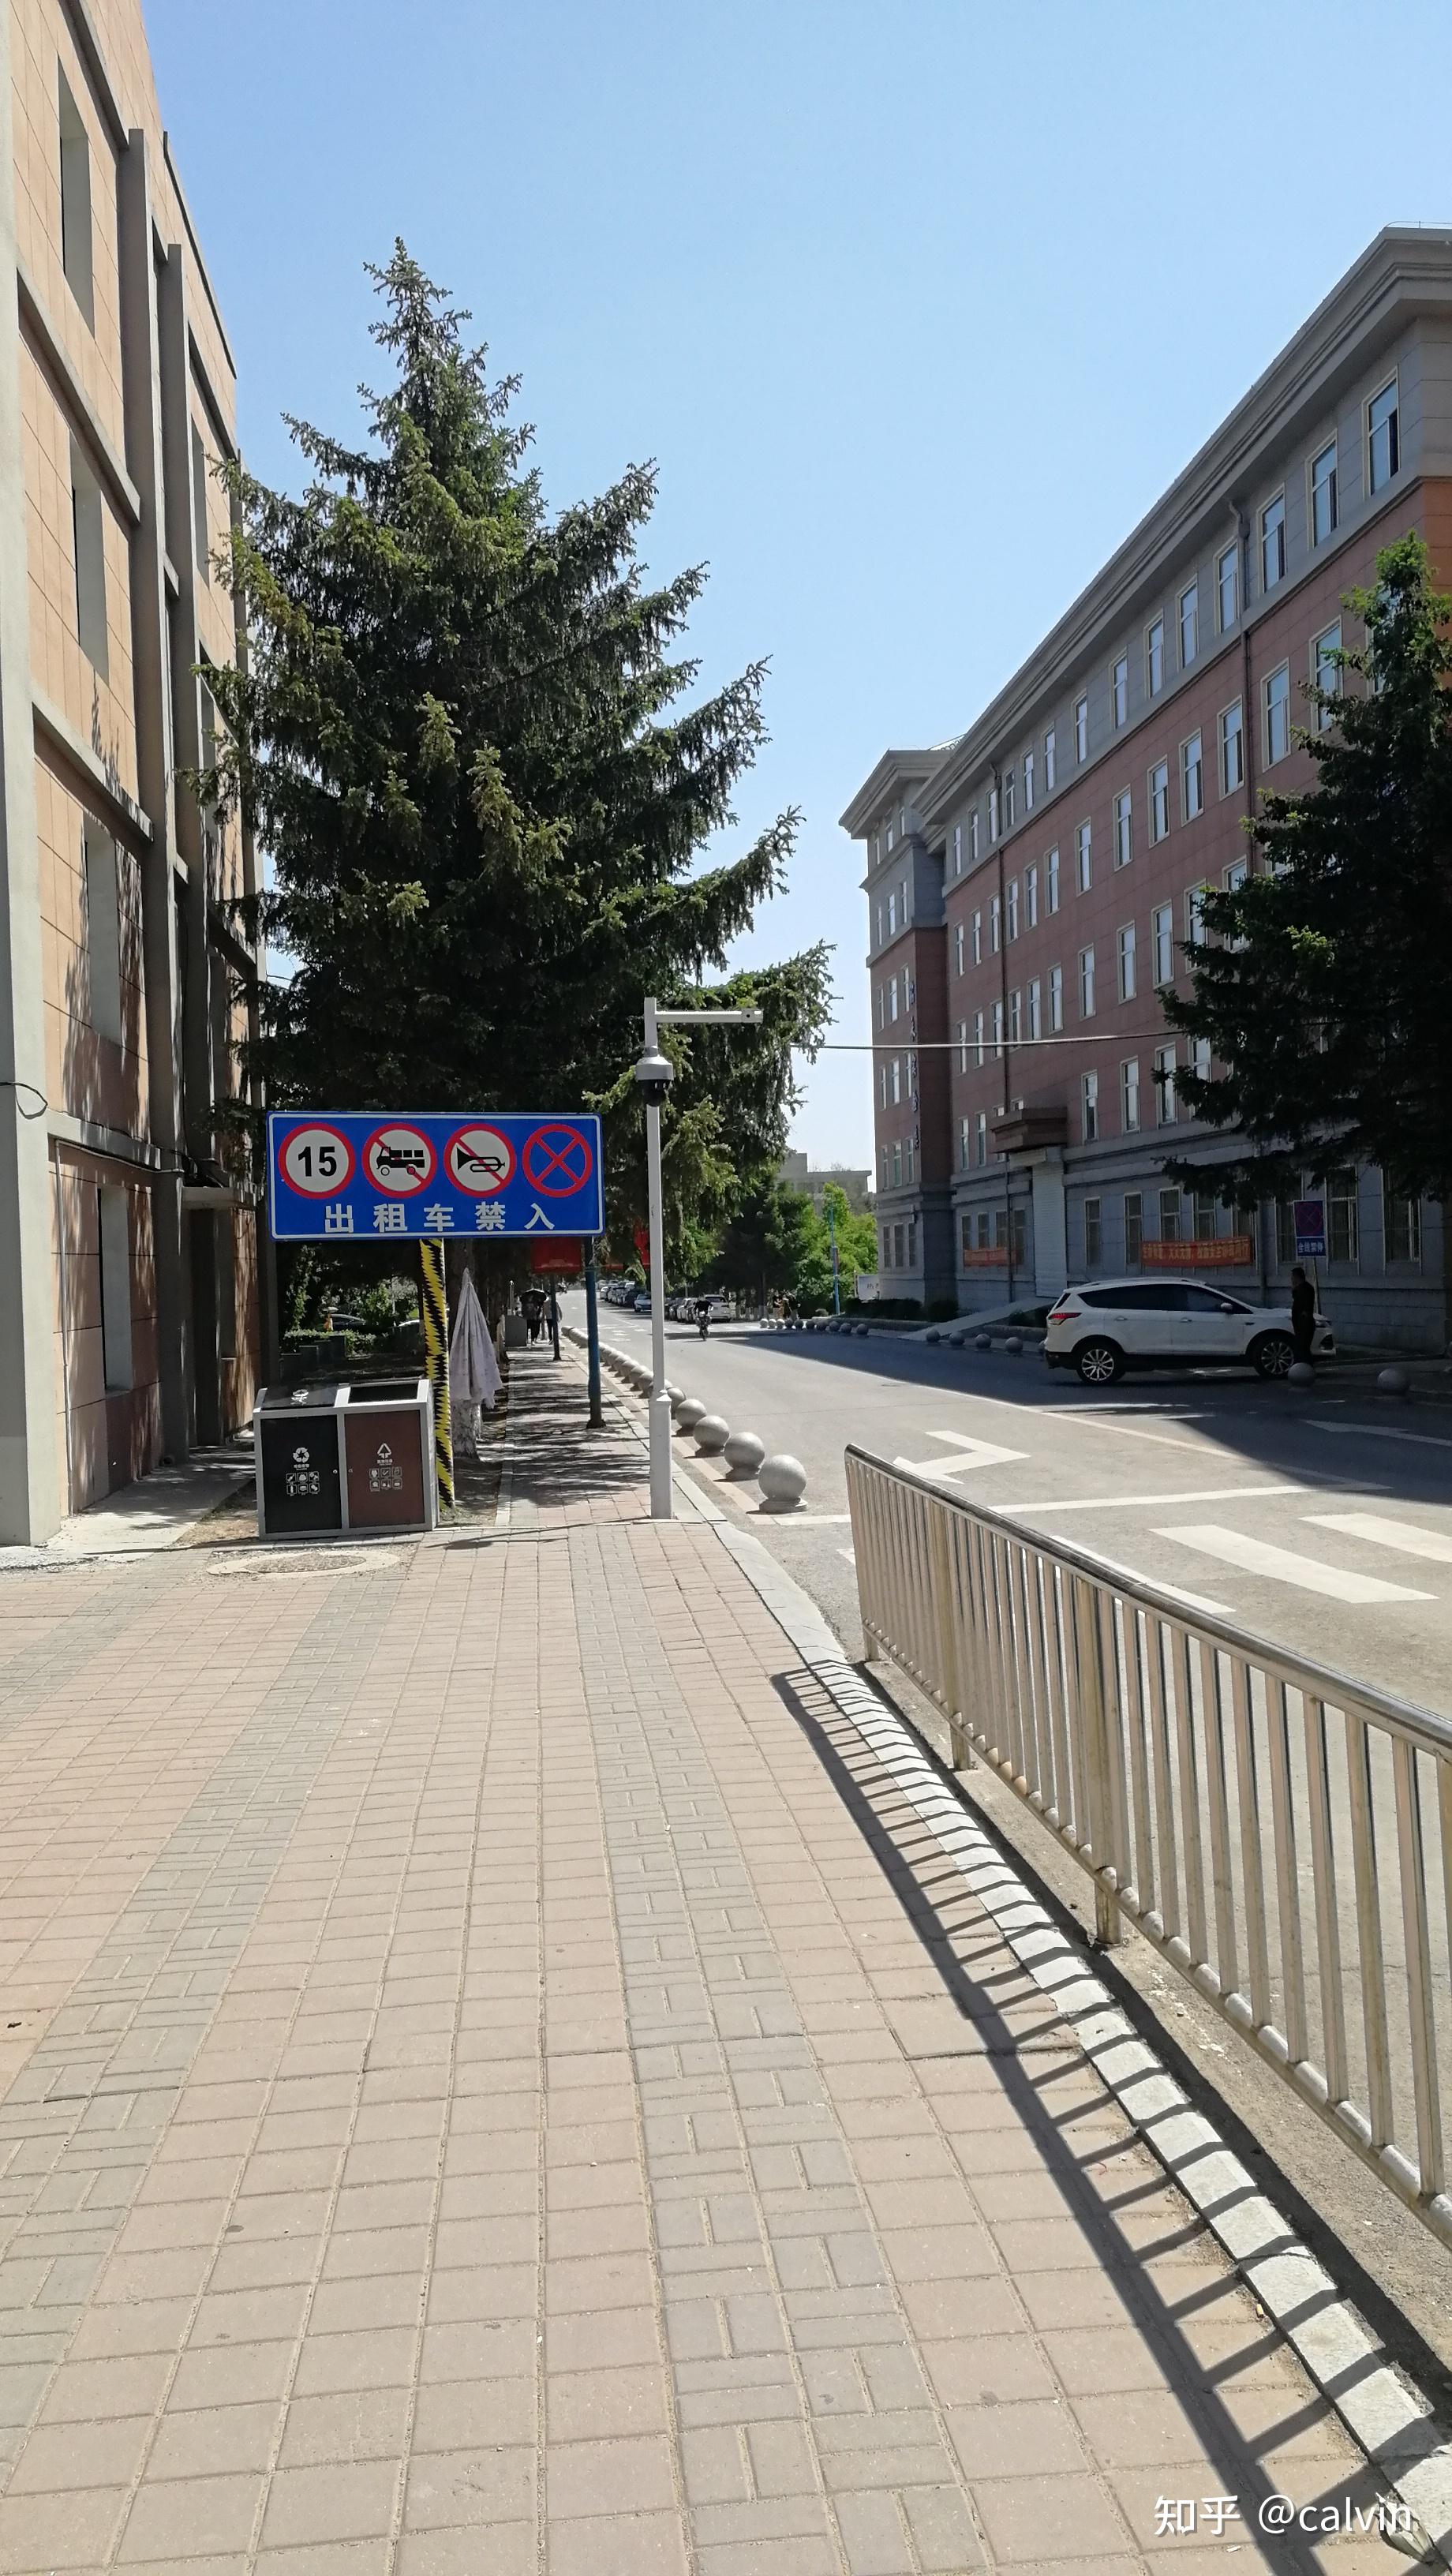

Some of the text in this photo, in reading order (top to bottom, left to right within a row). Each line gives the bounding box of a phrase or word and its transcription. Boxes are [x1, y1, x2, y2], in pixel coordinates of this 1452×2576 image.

[298, 1146, 337, 1177] 15
[324, 1202, 555, 1234] 出租车禁入
